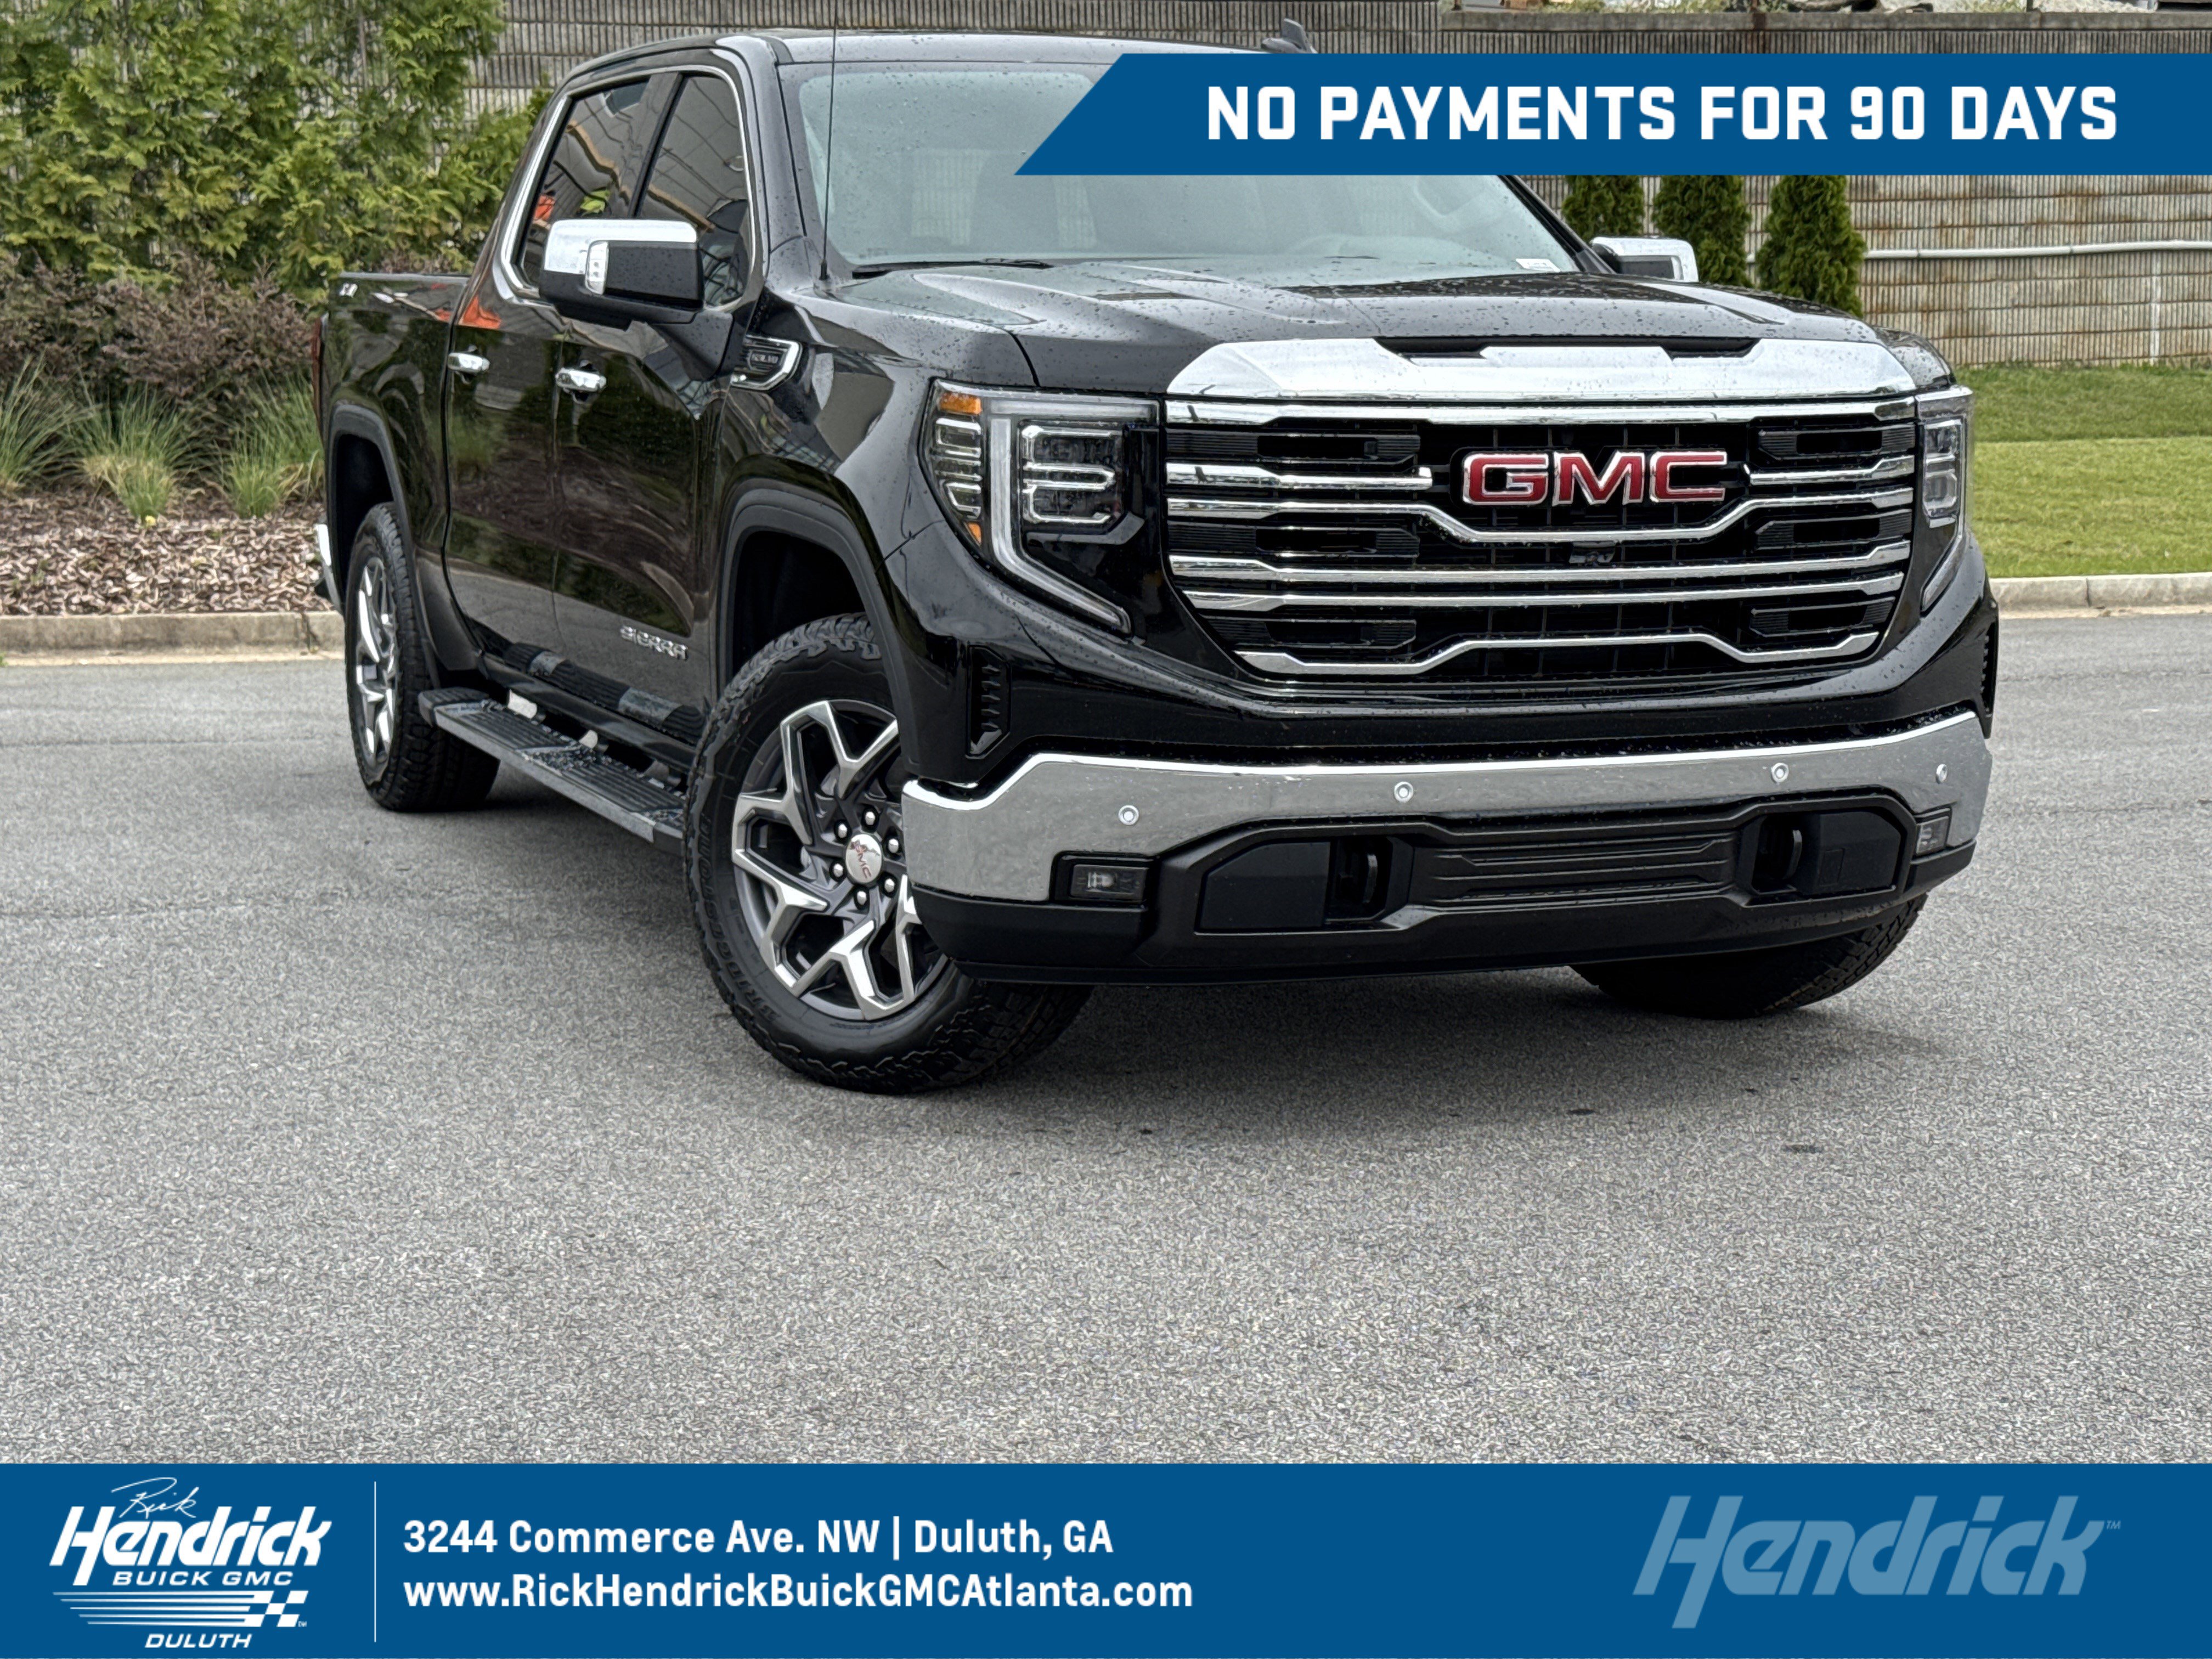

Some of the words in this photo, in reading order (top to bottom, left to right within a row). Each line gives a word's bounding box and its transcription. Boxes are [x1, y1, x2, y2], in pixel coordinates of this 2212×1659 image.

[1463, 451, 1728, 506] GMC
[620, 625, 688, 660] SIERRA
[852, 840, 872, 878] GMC
[698, 812, 781, 1022] BRIDGESTONE
